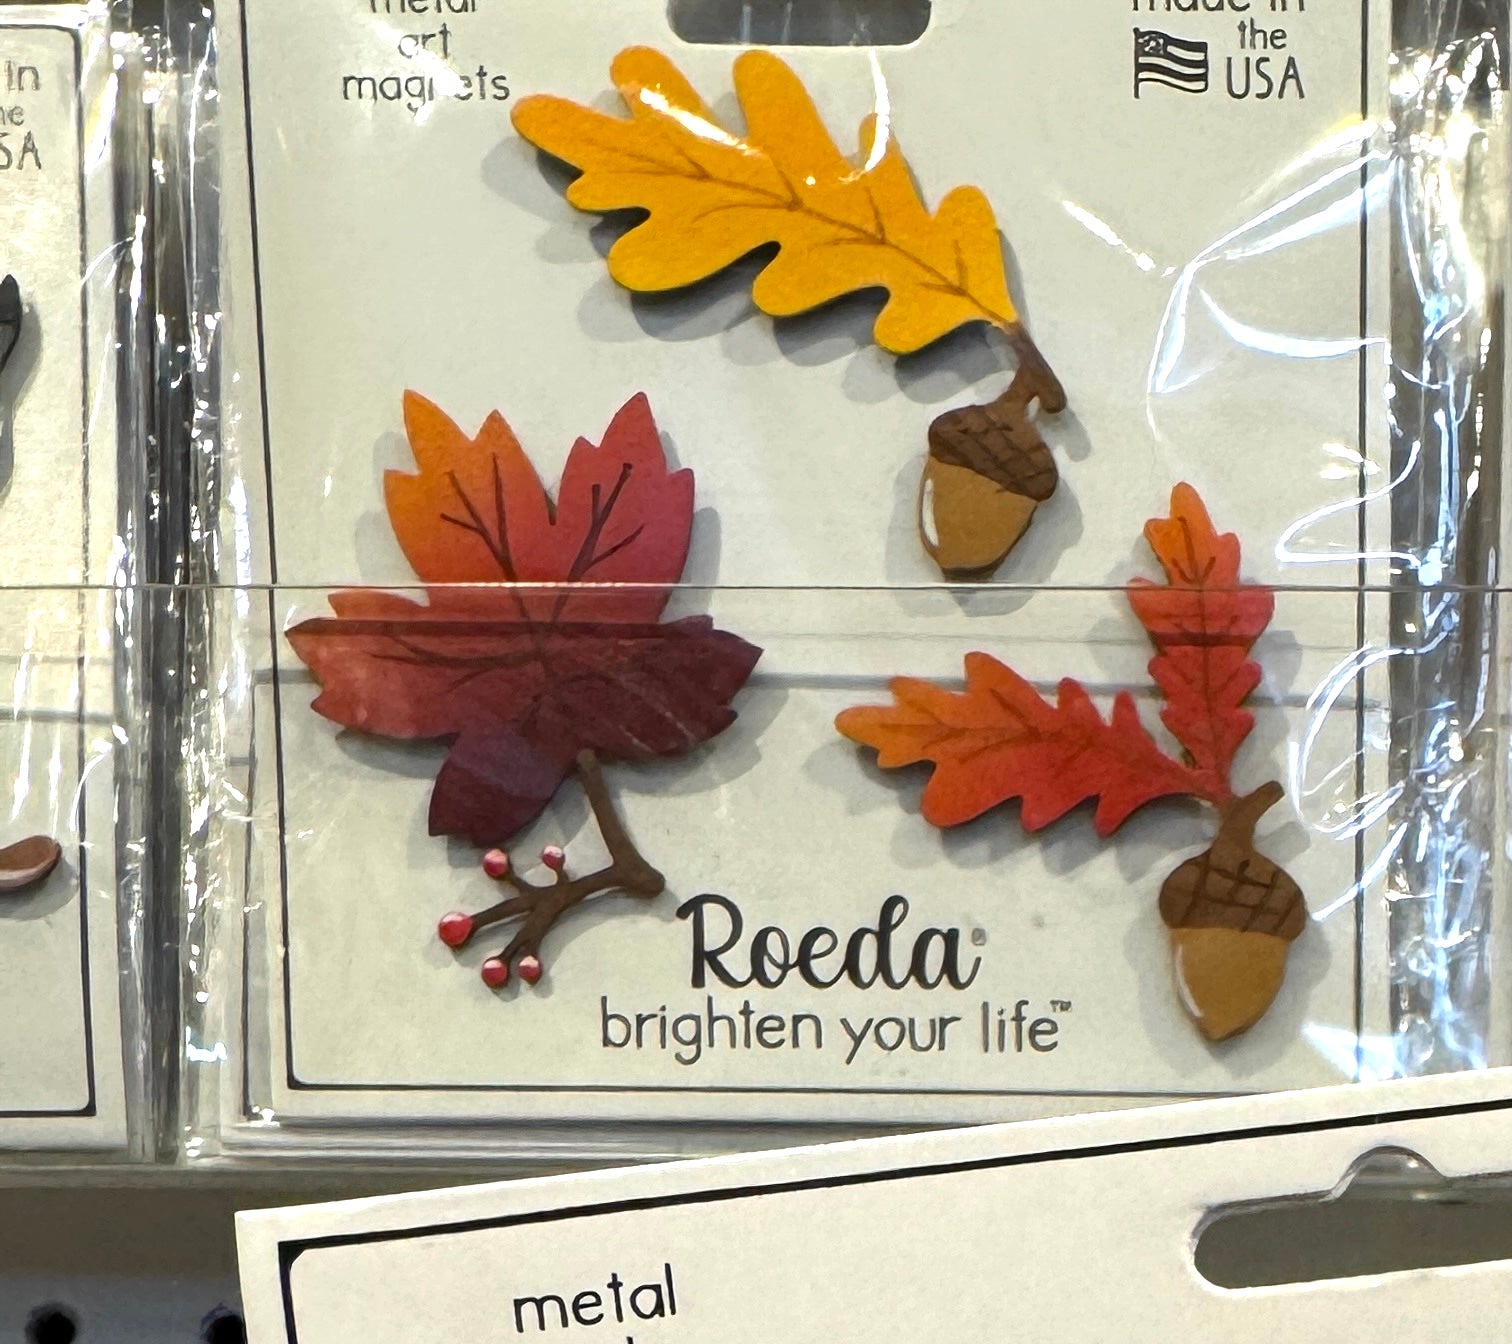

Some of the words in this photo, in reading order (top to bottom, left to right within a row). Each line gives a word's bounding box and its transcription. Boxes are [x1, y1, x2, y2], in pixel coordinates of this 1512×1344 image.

[1237, 17, 1287, 49] the
[1226, 55, 1305, 99] USA
[0, 131, 42, 170] SA
[600, 996, 822, 1066] brighten
[840, 1016, 962, 1065] your
[513, 1262, 677, 1333] metal
